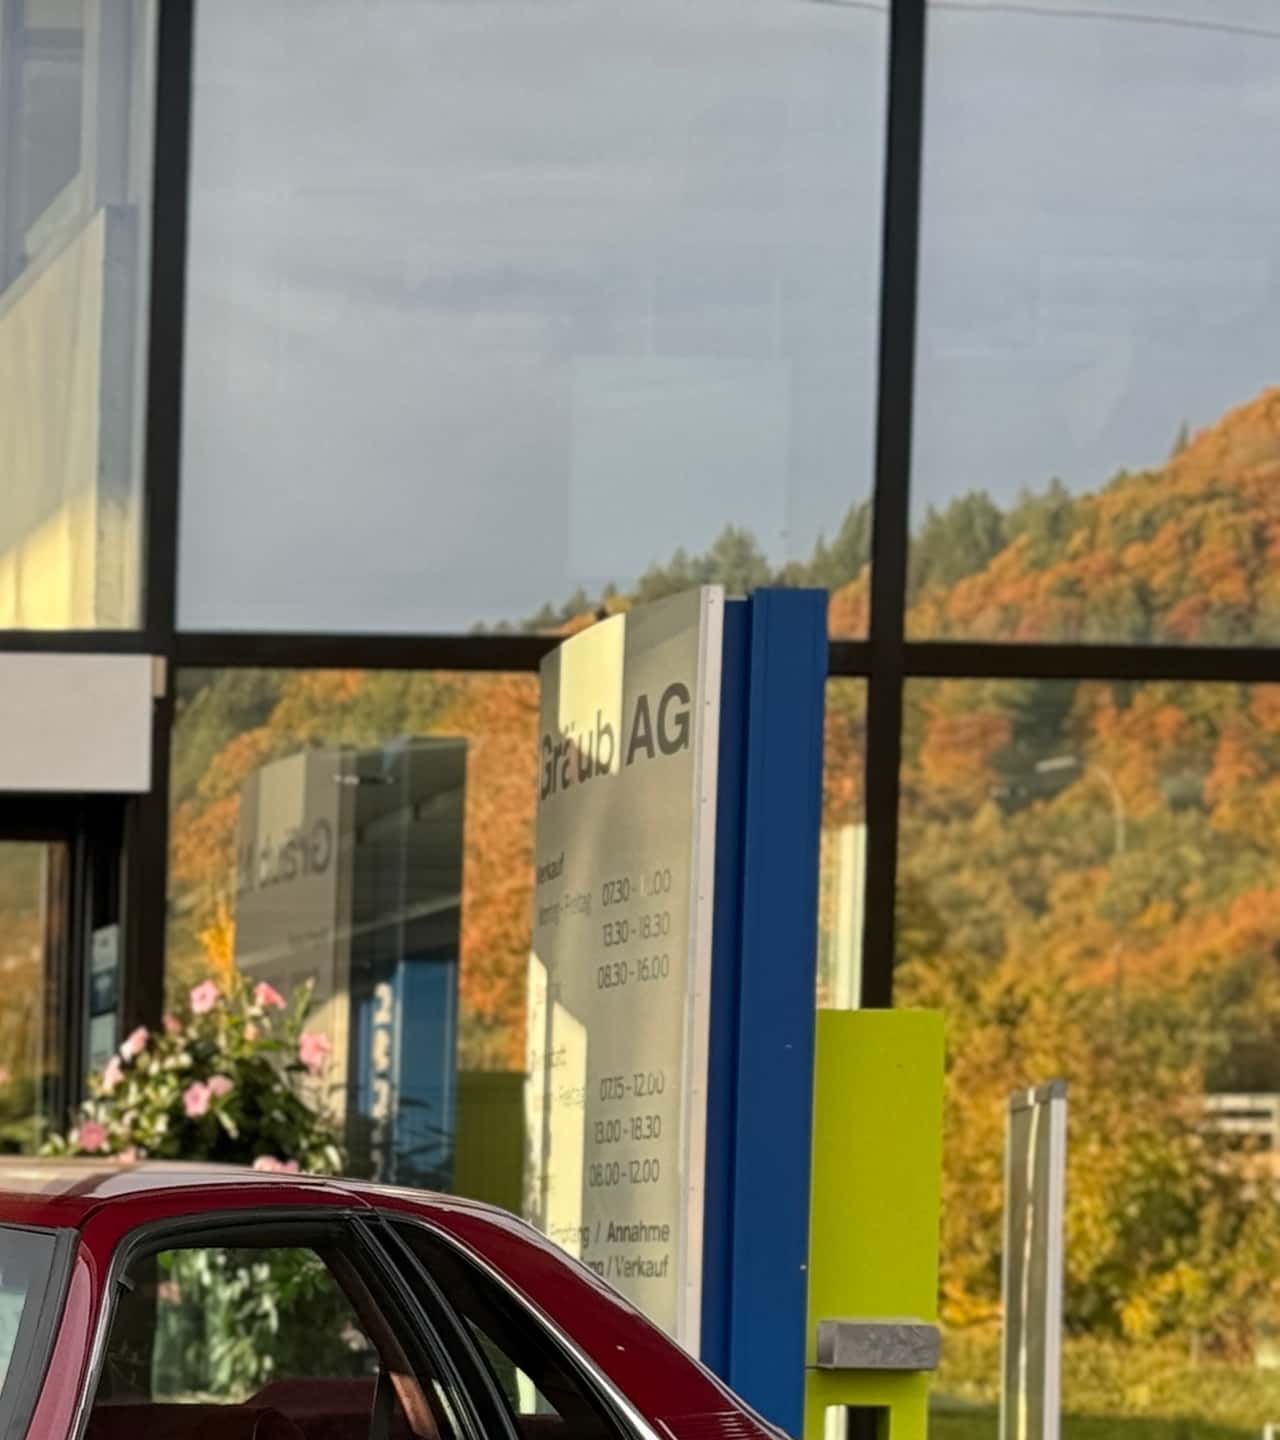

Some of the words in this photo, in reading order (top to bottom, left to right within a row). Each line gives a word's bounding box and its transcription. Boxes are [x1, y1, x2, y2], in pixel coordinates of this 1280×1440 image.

[626, 682, 691, 766] AG
[606, 1219, 671, 1243] Annahme
[615, 1254, 670, 1278] Verkauf
